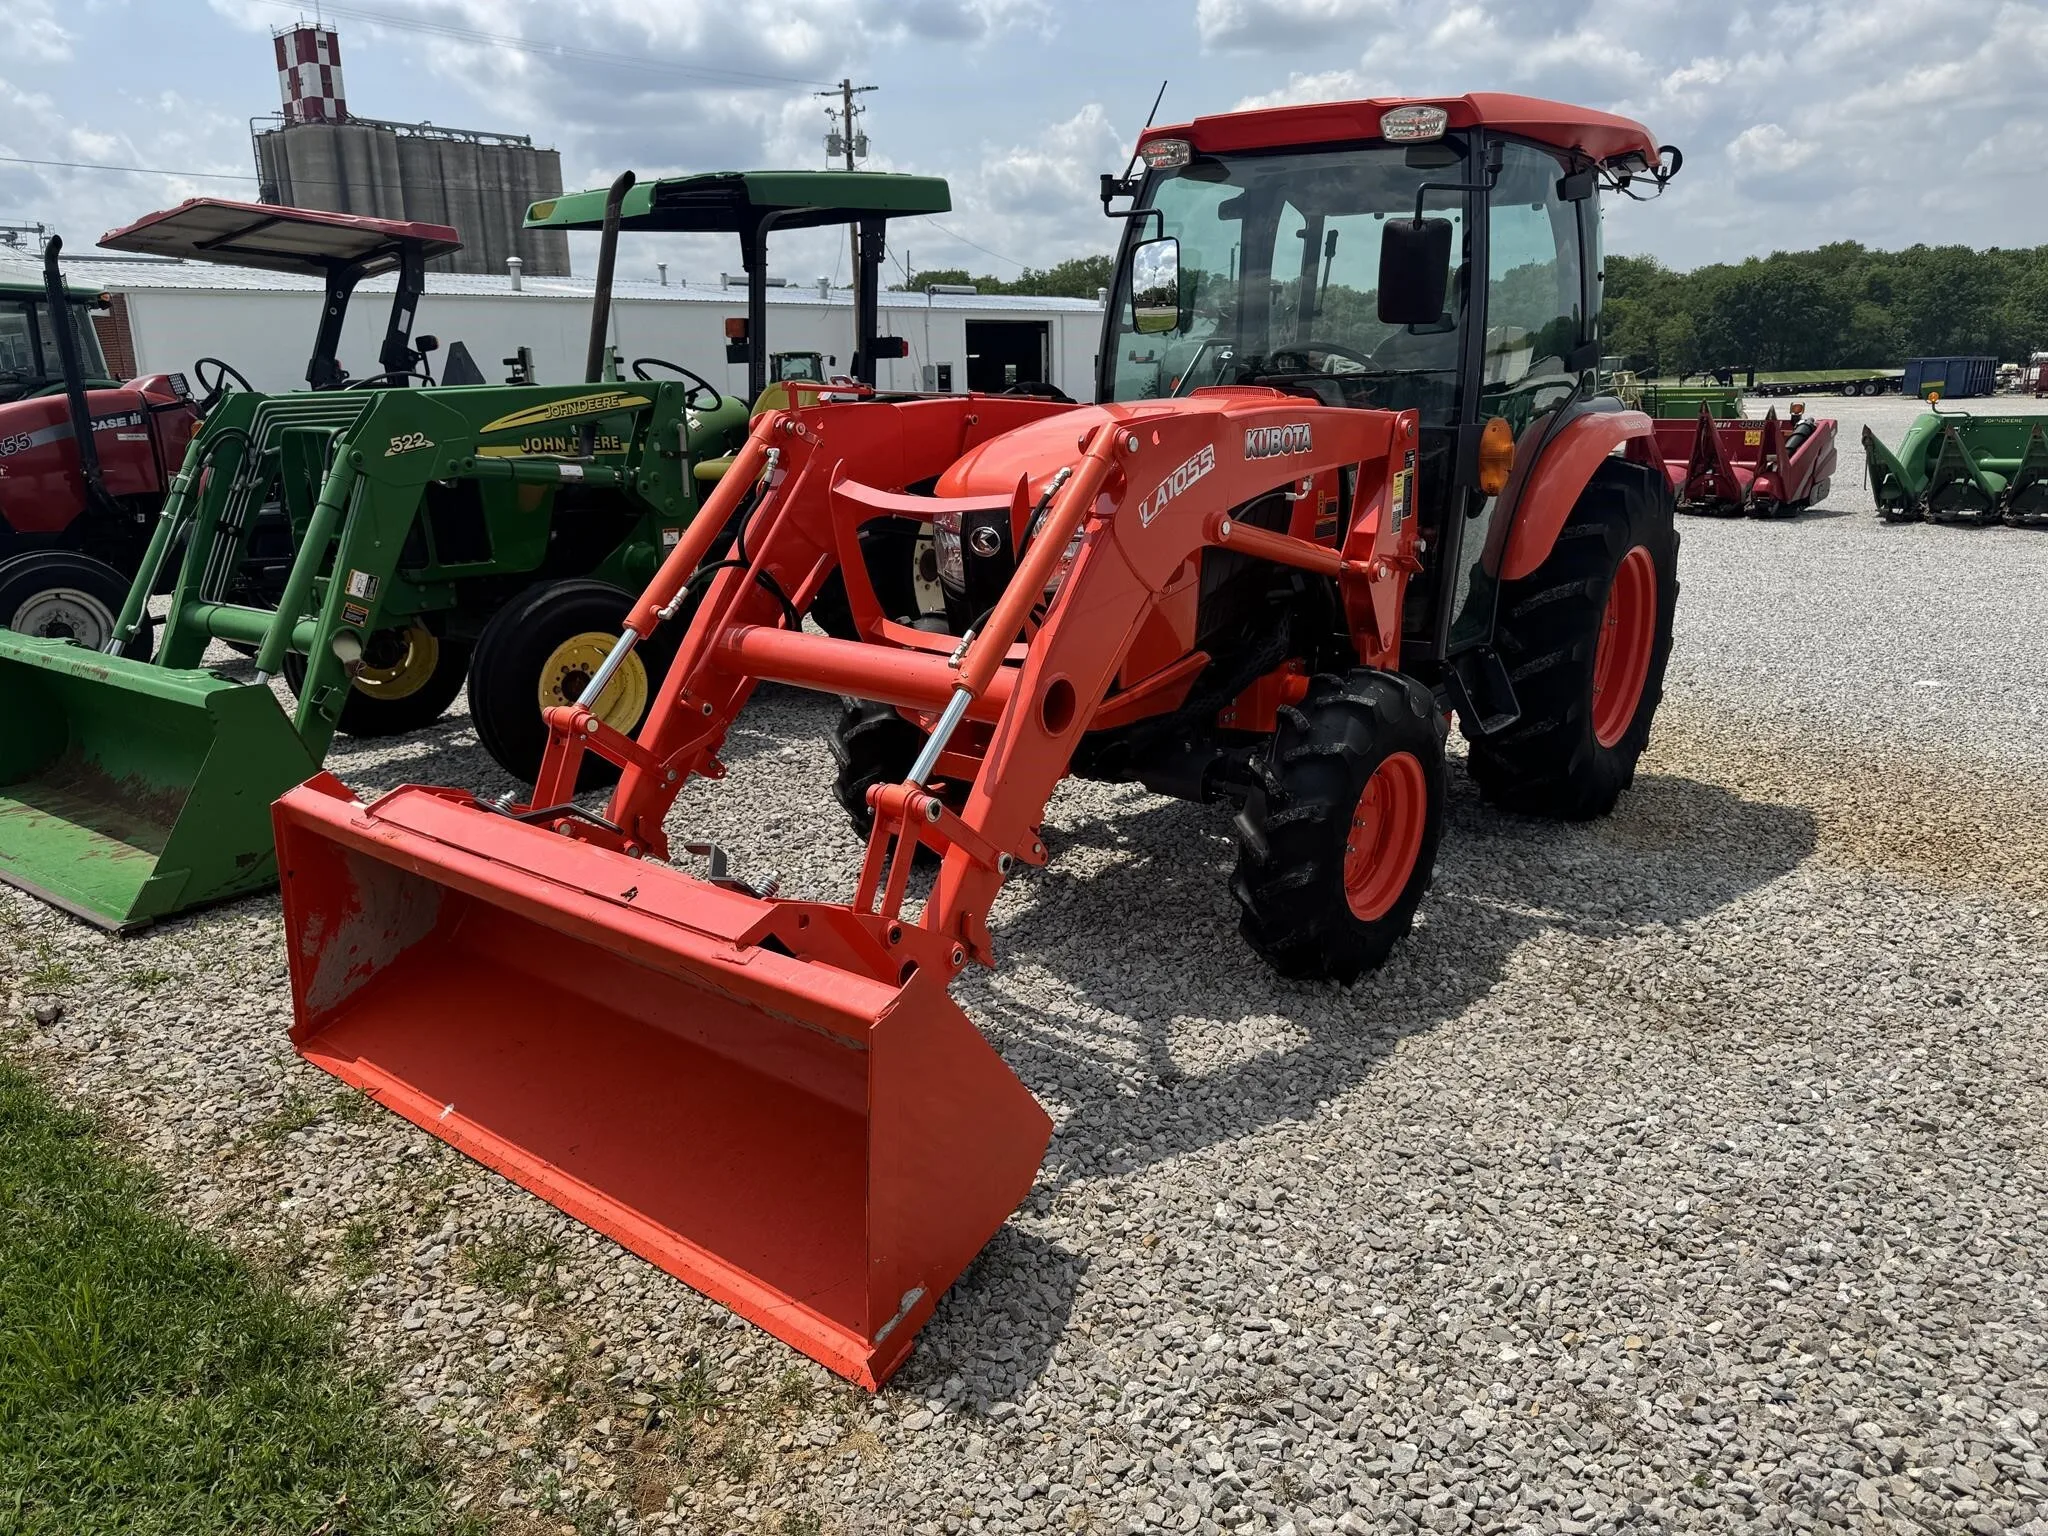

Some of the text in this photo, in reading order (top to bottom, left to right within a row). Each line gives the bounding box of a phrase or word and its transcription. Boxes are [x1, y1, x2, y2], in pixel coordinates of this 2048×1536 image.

[545, 396, 619, 419] JOHN DEERE
[390, 432, 426, 452] 522
[521, 435, 621, 453] JOHN DERE
[1245, 424, 1312, 460] KUBOTA
[1140, 444, 1215, 525] LA1055
